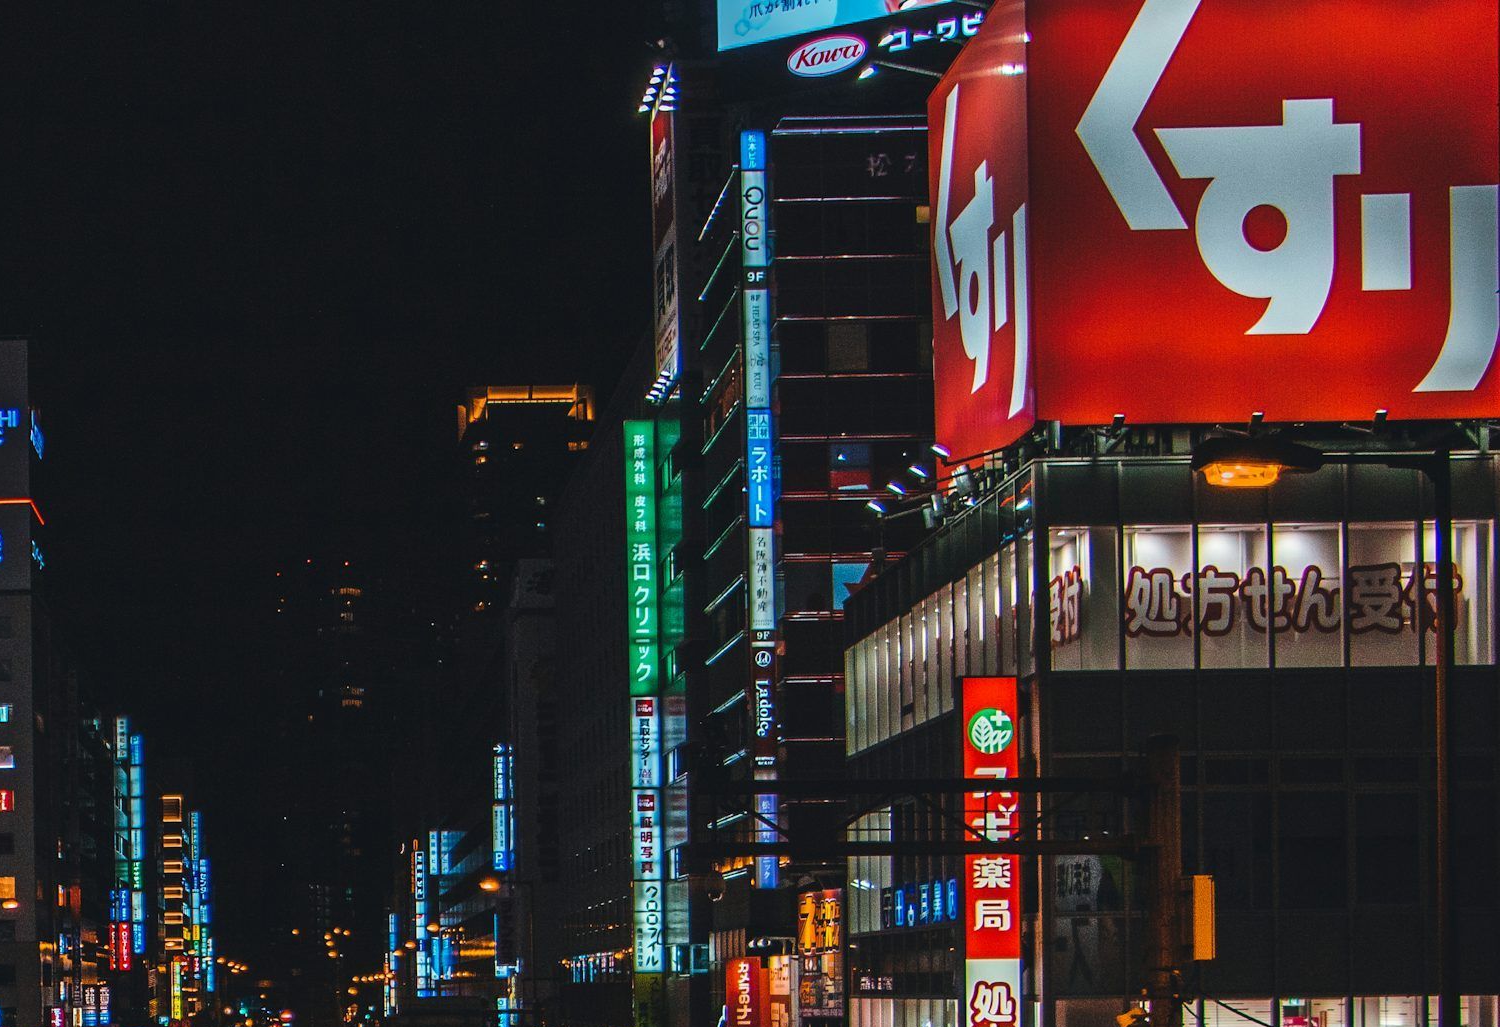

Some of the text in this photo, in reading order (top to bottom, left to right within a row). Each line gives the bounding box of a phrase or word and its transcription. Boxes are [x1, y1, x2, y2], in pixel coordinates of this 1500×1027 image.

[795, 43, 862, 71] Kowa
[1075, 0, 1499, 392] くすり
[747, 271, 764, 282] 9F
[934, 83, 1027, 419] くすり
[751, 446, 768, 522] ラポート
[632, 434, 651, 682] 形成外科 皮フ科 浜口クリニック
[756, 631, 770, 640] 9F
[639, 815, 654, 875] 証明写真
